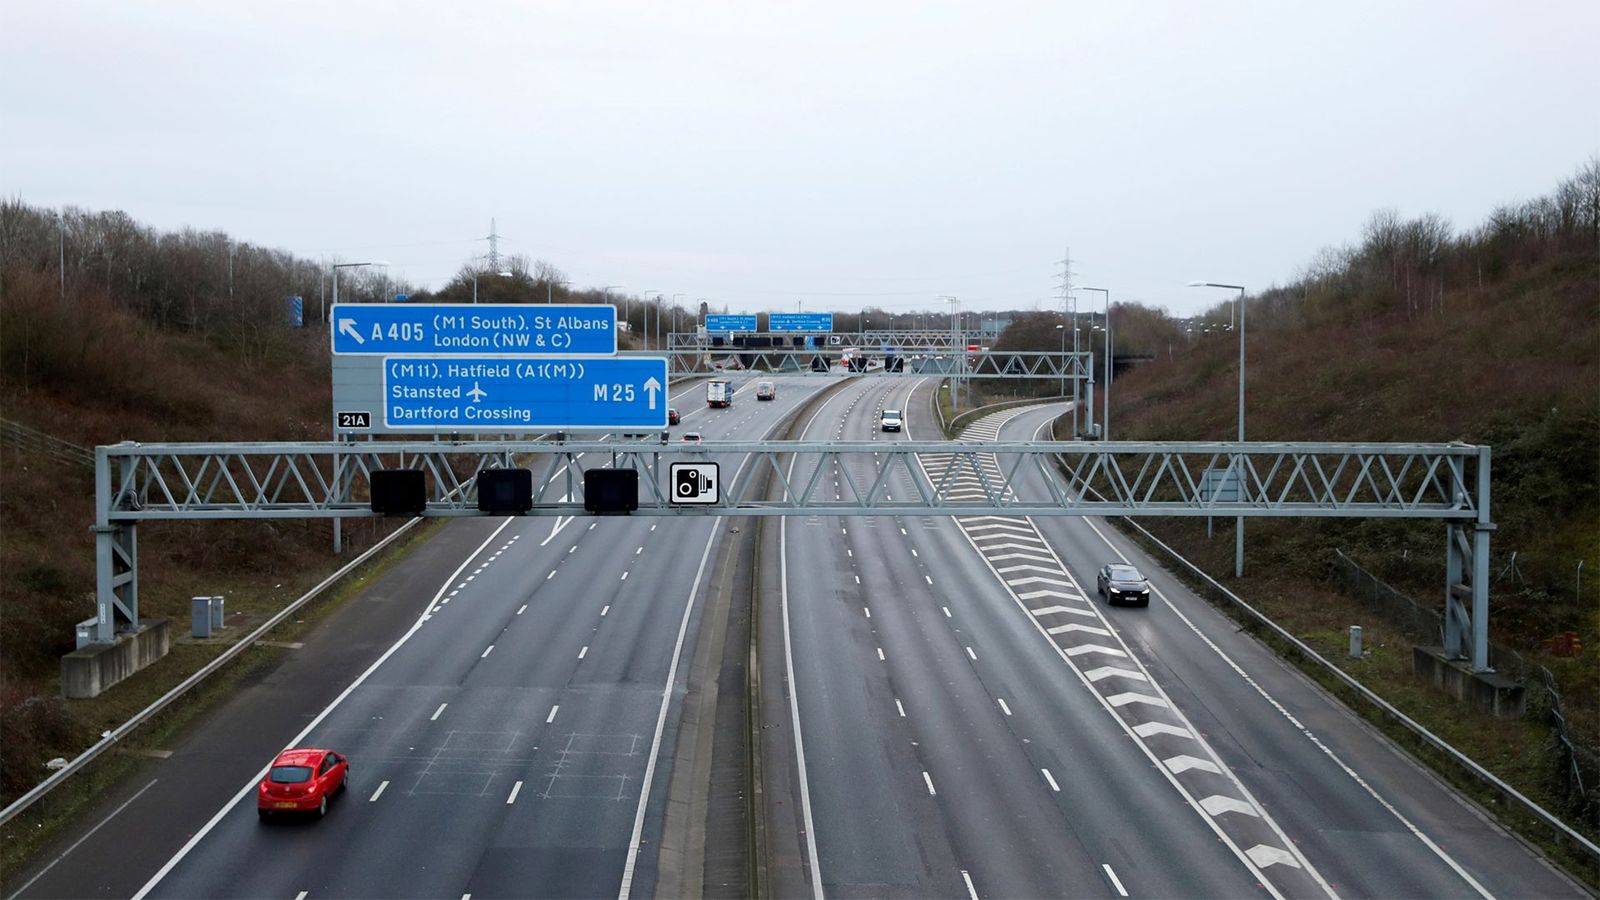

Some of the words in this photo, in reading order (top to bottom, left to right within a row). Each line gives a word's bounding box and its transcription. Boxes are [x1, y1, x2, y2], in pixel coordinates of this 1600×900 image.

[433, 314, 465, 331] (M1
[534, 316, 552, 330] St
[557, 316, 609, 330] Albans
[434, 334, 489, 347] London
[493, 332, 530, 348] (NW
[535, 334, 546, 347] &
[551, 332, 571, 348] C)
[448, 364, 510, 378] Hatfield
[516, 363, 585, 379] (A1(M))
[392, 385, 461, 398] Stansted
[342, 414, 366, 426] 21A
[393, 406, 459, 419] Dartford
[464, 406, 531, 422] Crossing
